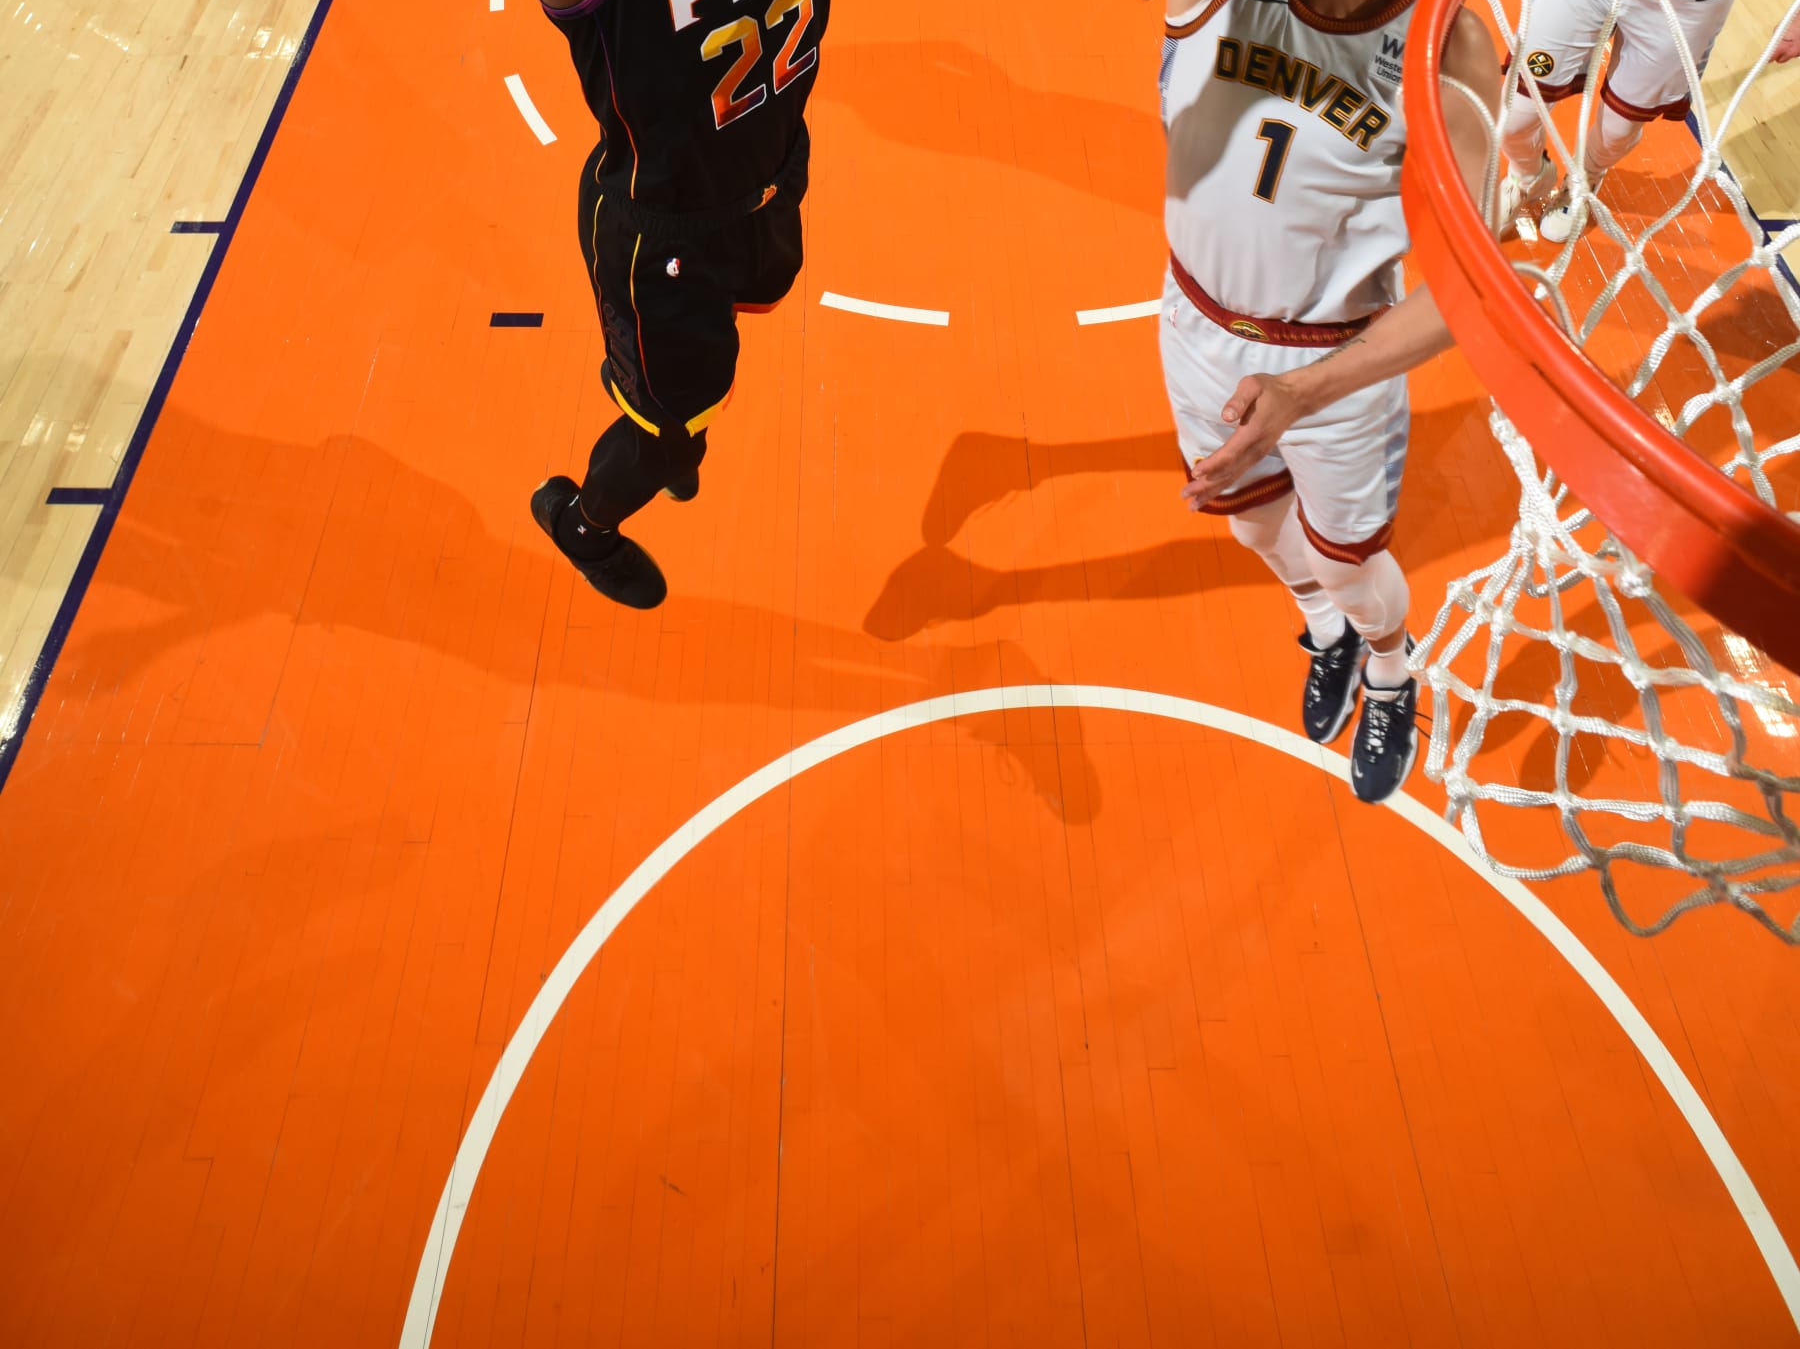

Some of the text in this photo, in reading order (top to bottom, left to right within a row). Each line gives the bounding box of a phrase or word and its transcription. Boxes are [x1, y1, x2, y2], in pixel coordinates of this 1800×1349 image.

[1375, 54, 1403, 74] Weste
[1382, 34, 1405, 60] W
[1214, 35, 1392, 153] DENVER
[1253, 117, 1297, 204] 1
